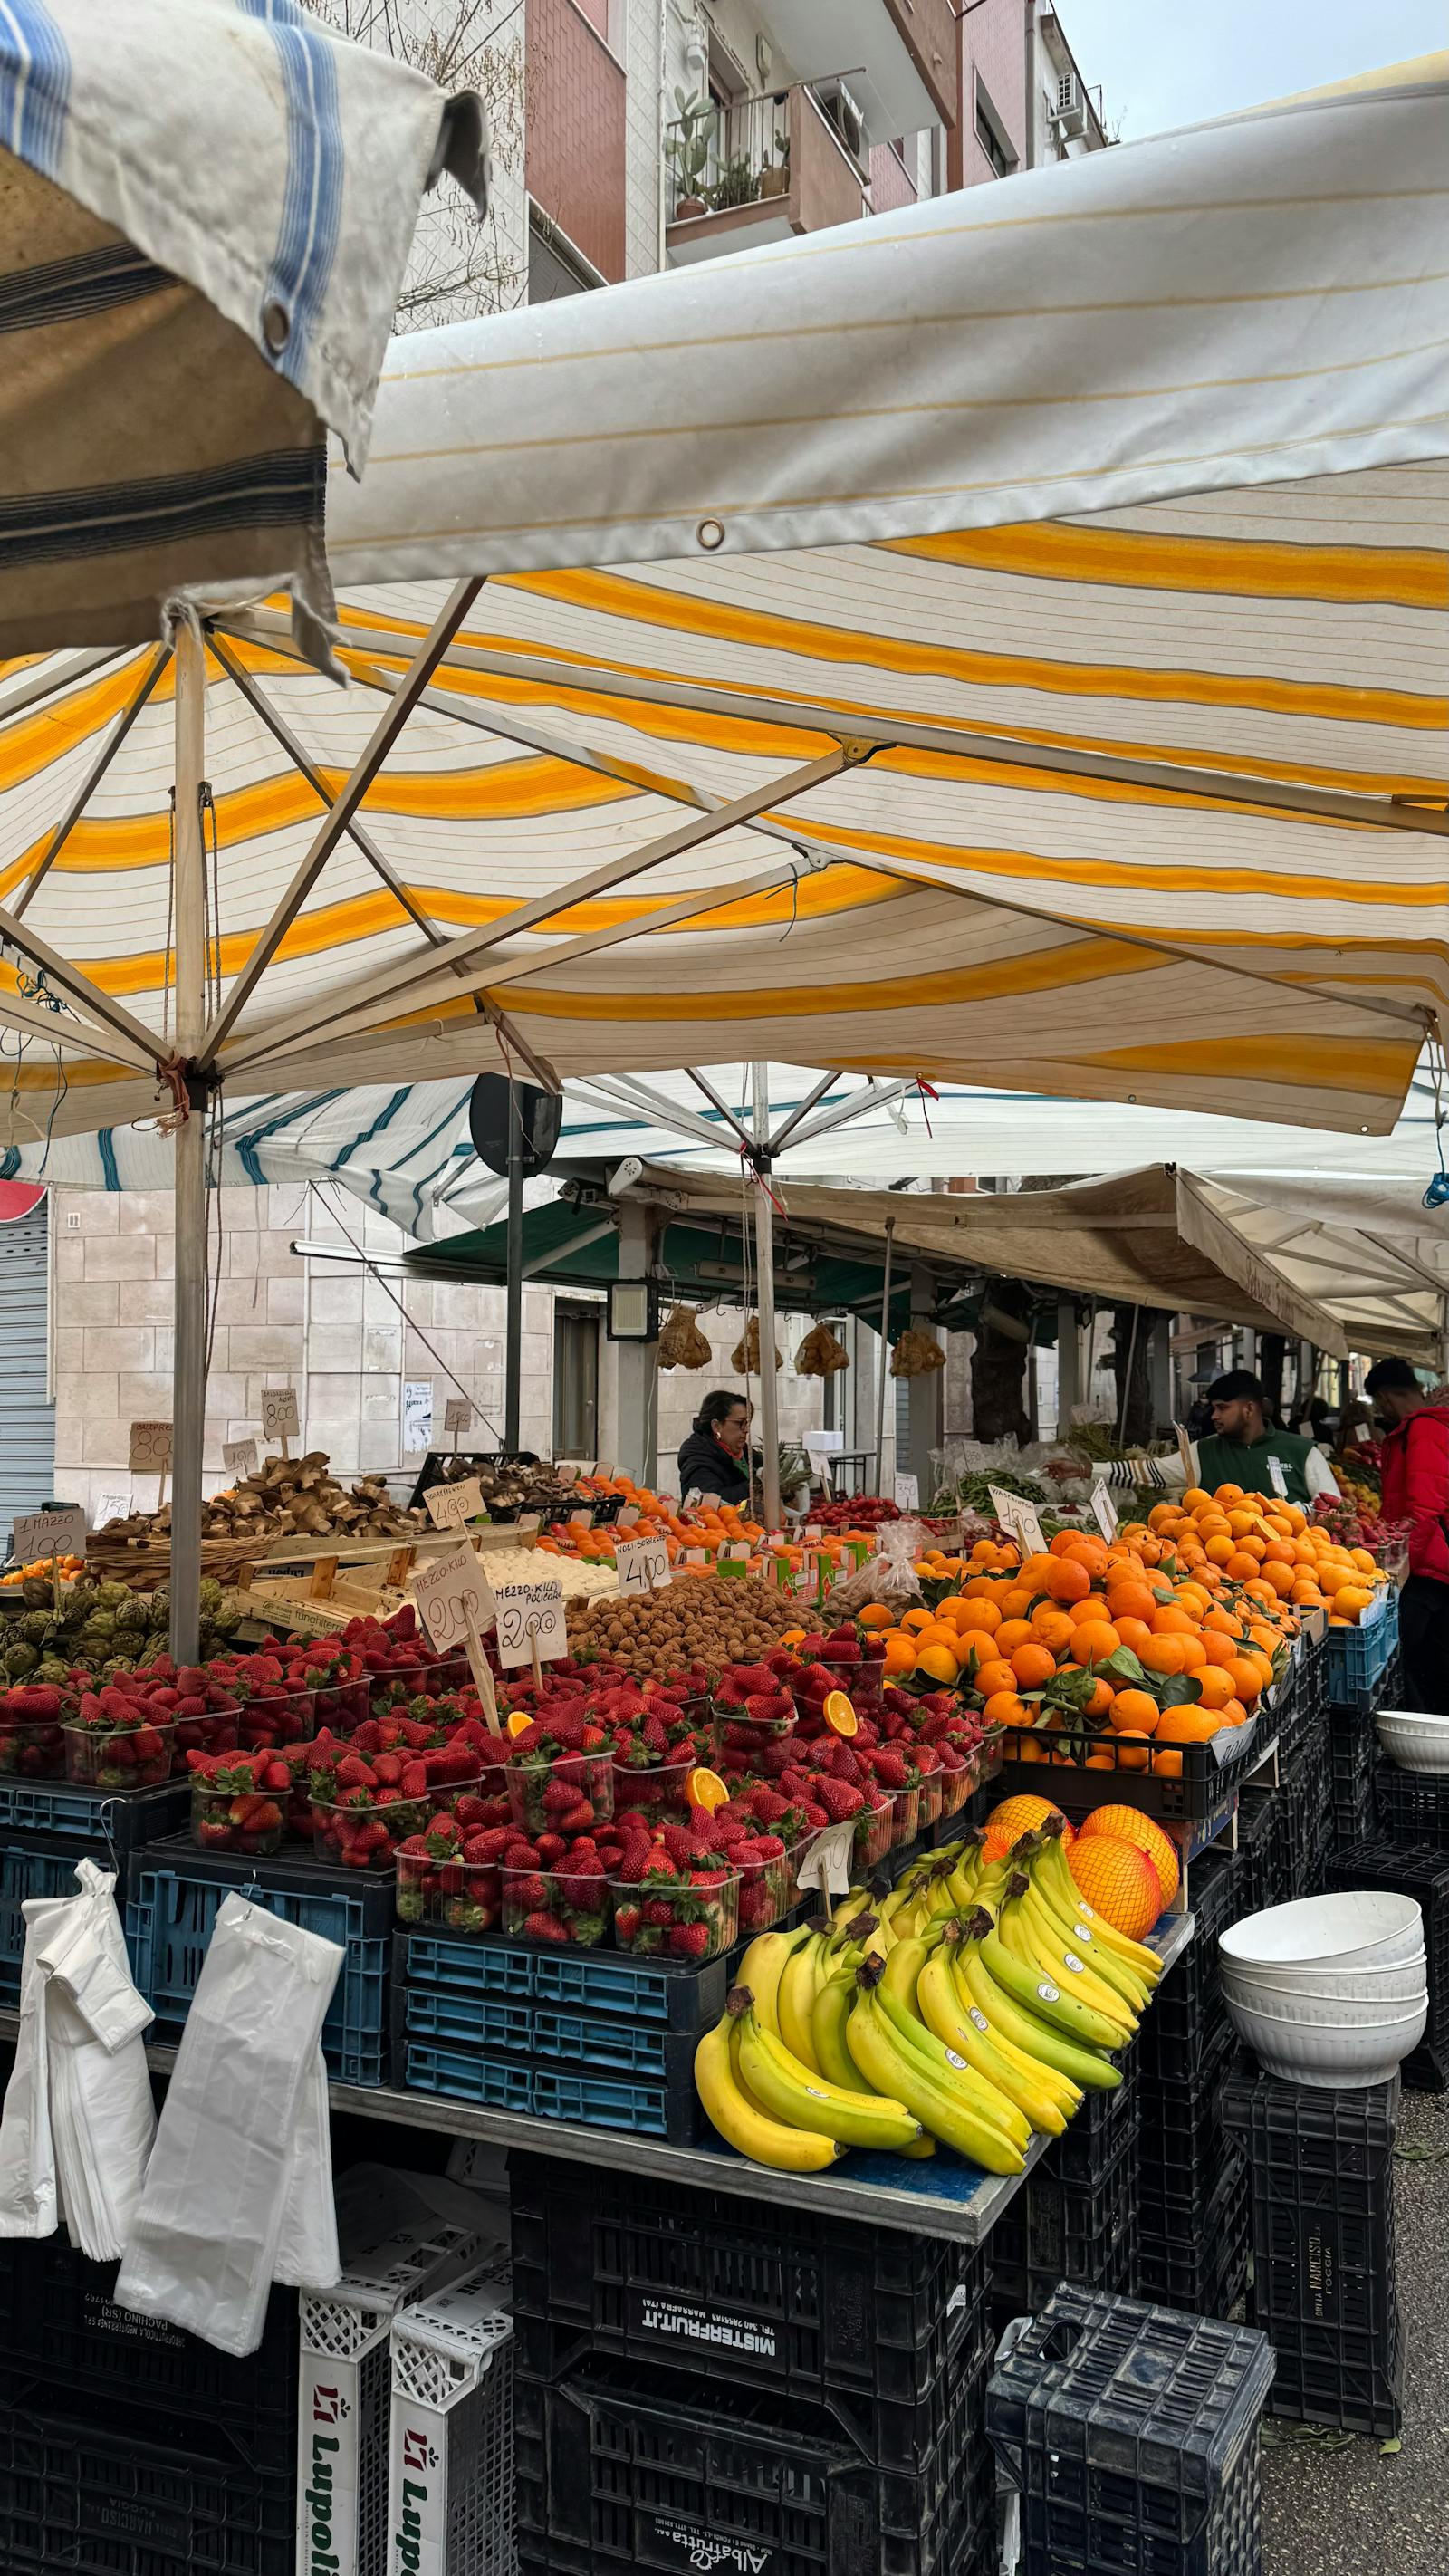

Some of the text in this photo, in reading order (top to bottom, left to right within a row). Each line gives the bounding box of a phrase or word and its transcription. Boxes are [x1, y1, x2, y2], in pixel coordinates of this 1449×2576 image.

[132, 1431, 173, 1460] 80
[34, 1515, 74, 1529] MAZZO
[21, 1534, 72, 1559] 100
[502, 1608, 557, 1648] 200
[1309, 2236, 1322, 2290] NARCISO
[124, 2312, 168, 2331] PACHINO
[661, 2302, 706, 2319] MASSAFRA
[642, 2310, 776, 2356] MISTERFRUIT.IT
[672, 2531, 768, 2574] Albafrutta
